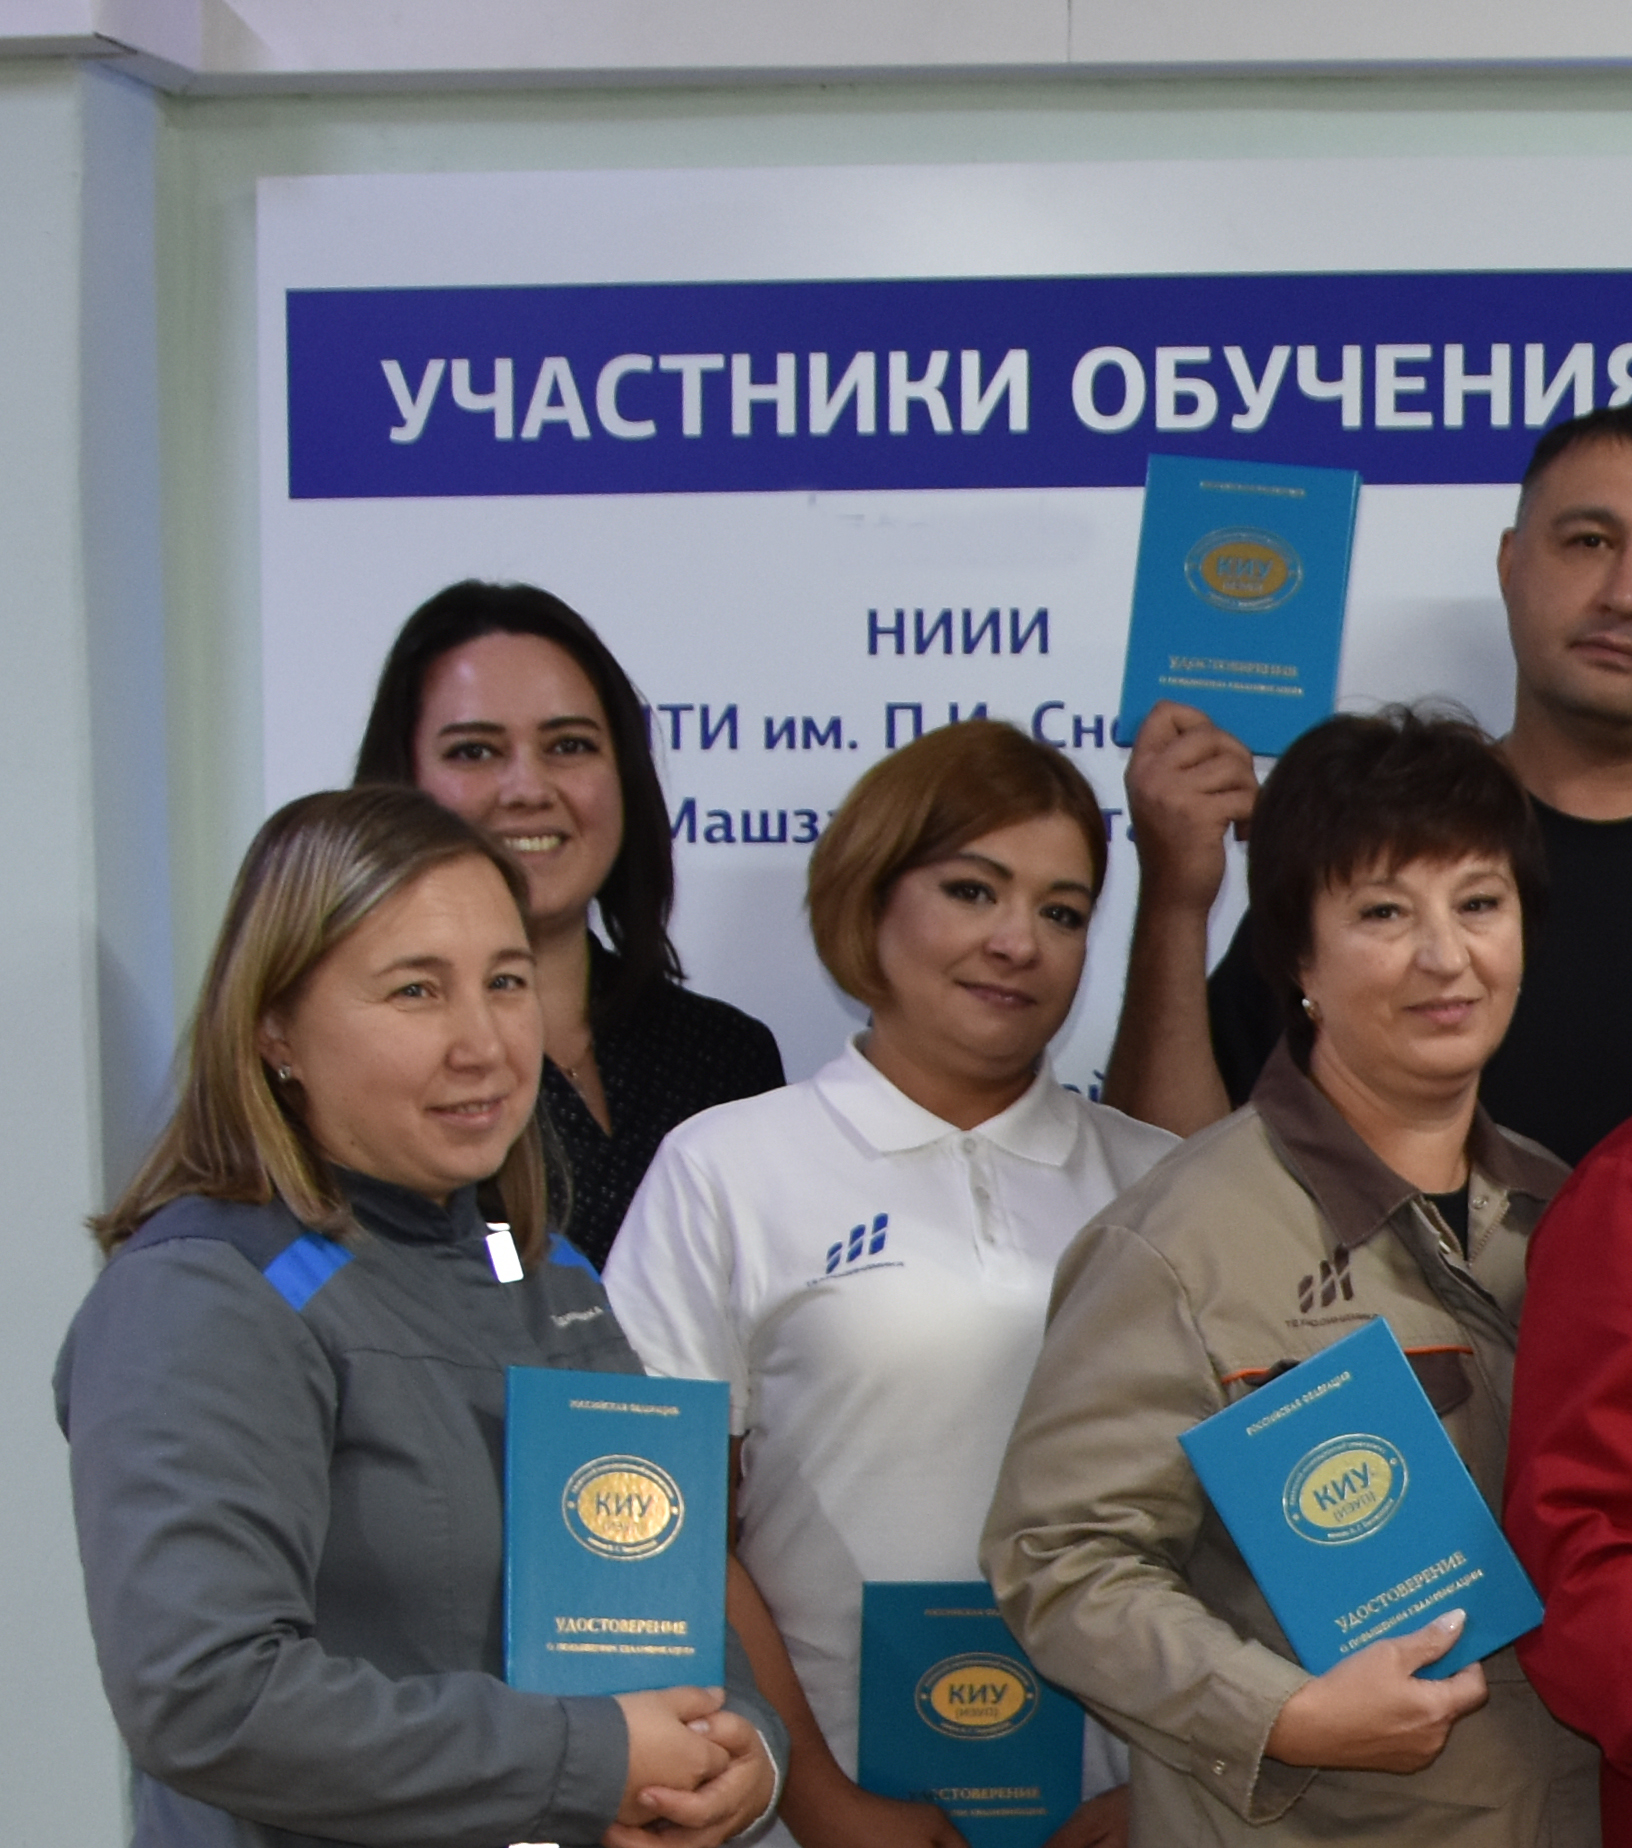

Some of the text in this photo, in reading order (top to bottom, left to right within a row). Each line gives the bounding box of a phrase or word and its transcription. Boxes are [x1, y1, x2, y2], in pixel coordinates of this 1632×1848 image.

[380, 348, 1029, 442] УЧАСТНИКИ
[866, 608, 1050, 655] НИИИ
[643, 704, 738, 750] ТИ
[765, 716, 858, 750] им.
[594, 1492, 652, 1517] КИУ
[1313, 1462, 1371, 1512] КИУ
[1334, 1550, 1468, 1633] УДОСТОВЕРЕНИЕ
[948, 1683, 1009, 1704] КИУ
[910, 1786, 1040, 1800] СТОВЕРЕНИЕ
